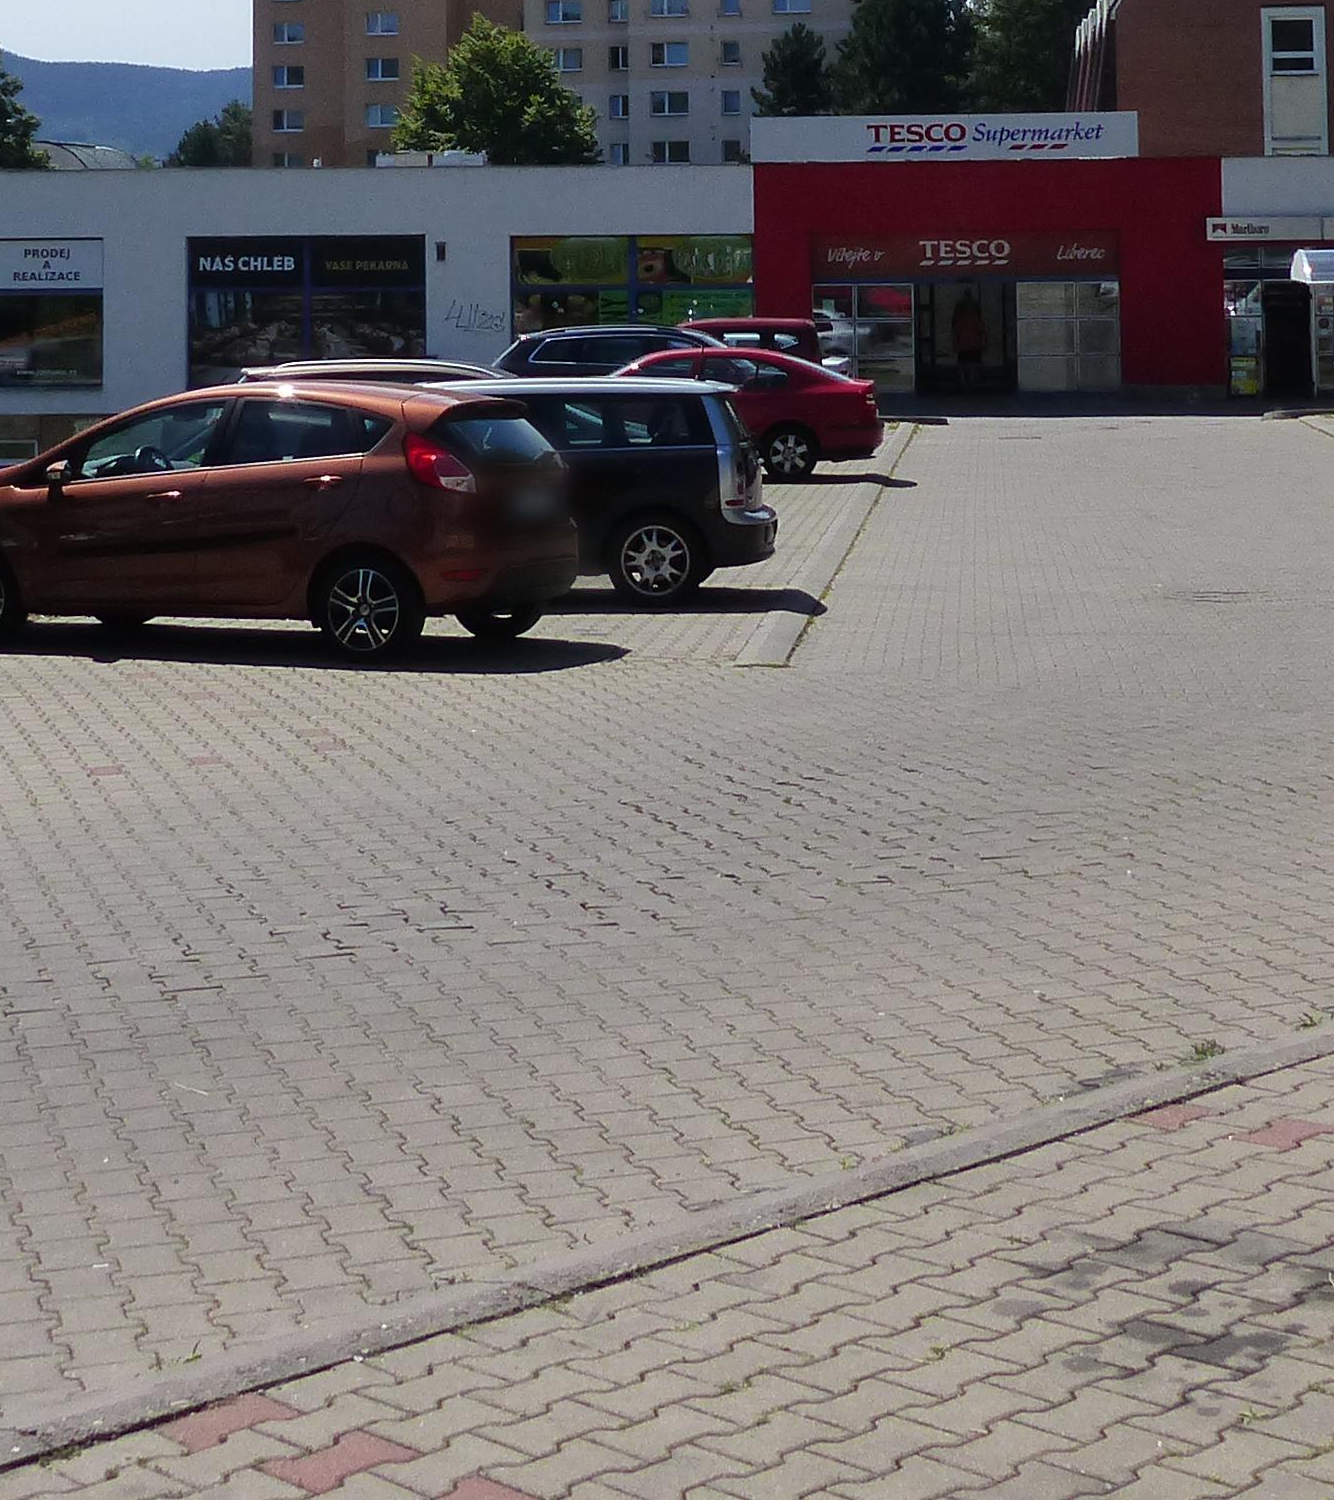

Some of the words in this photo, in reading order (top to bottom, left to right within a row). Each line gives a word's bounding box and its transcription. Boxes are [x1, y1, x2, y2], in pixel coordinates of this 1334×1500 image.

[867, 123, 967, 143] TESCO
[972, 122, 1104, 146] Supermarket
[24, 249, 71, 260] PRODEJ
[919, 239, 1010, 258] TESCO
[1057, 242, 1105, 260] Liberec
[43, 261, 51, 270] A
[238, 254, 295, 272] CHLÉB
[13, 271, 81, 282] REALIZACE
